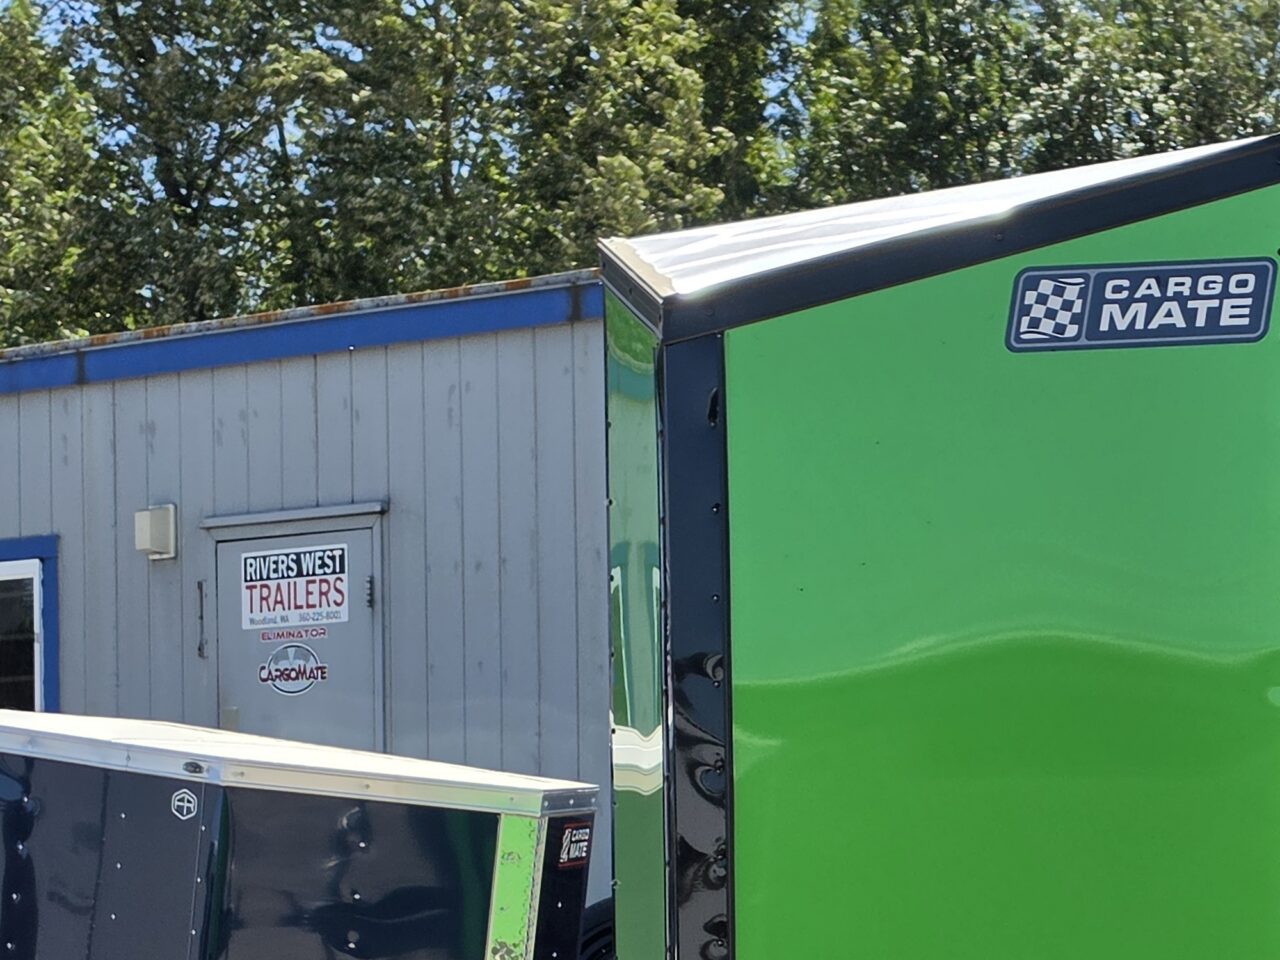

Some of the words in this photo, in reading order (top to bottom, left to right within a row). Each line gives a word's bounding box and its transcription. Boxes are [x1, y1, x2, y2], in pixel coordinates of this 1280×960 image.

[1104, 273, 1256, 299] CARGO
[1099, 297, 1253, 331] MATE
[246, 554, 297, 581] RIVERS
[301, 550, 342, 576] WEST
[245, 577, 345, 614] TRAILERS
[261, 628, 326, 640] ELIMINATOR
